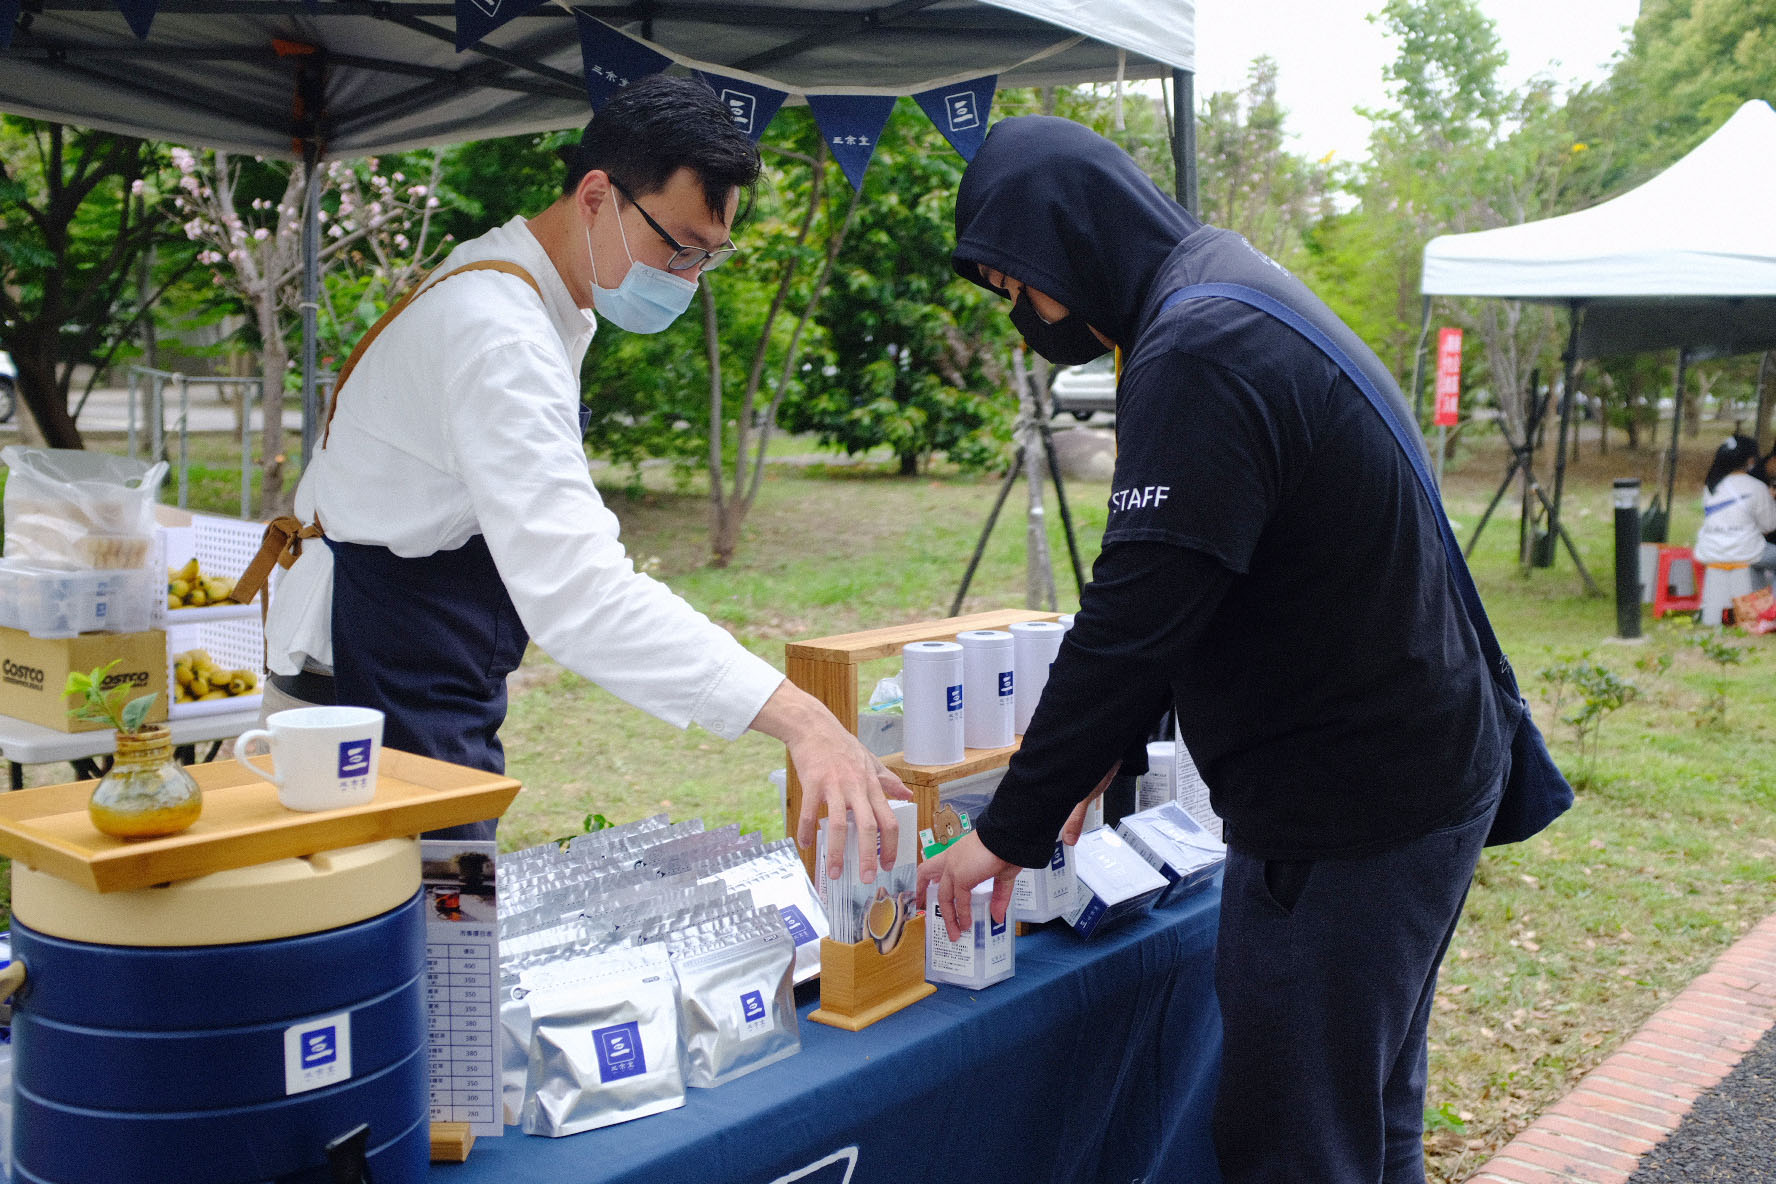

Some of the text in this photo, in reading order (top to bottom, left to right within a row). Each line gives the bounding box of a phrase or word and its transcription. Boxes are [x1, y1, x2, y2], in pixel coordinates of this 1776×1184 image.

[1112, 486, 1170, 513] STAFF
[3, 659, 44, 683] COSTCO
[100, 671, 149, 686] OSTCO
